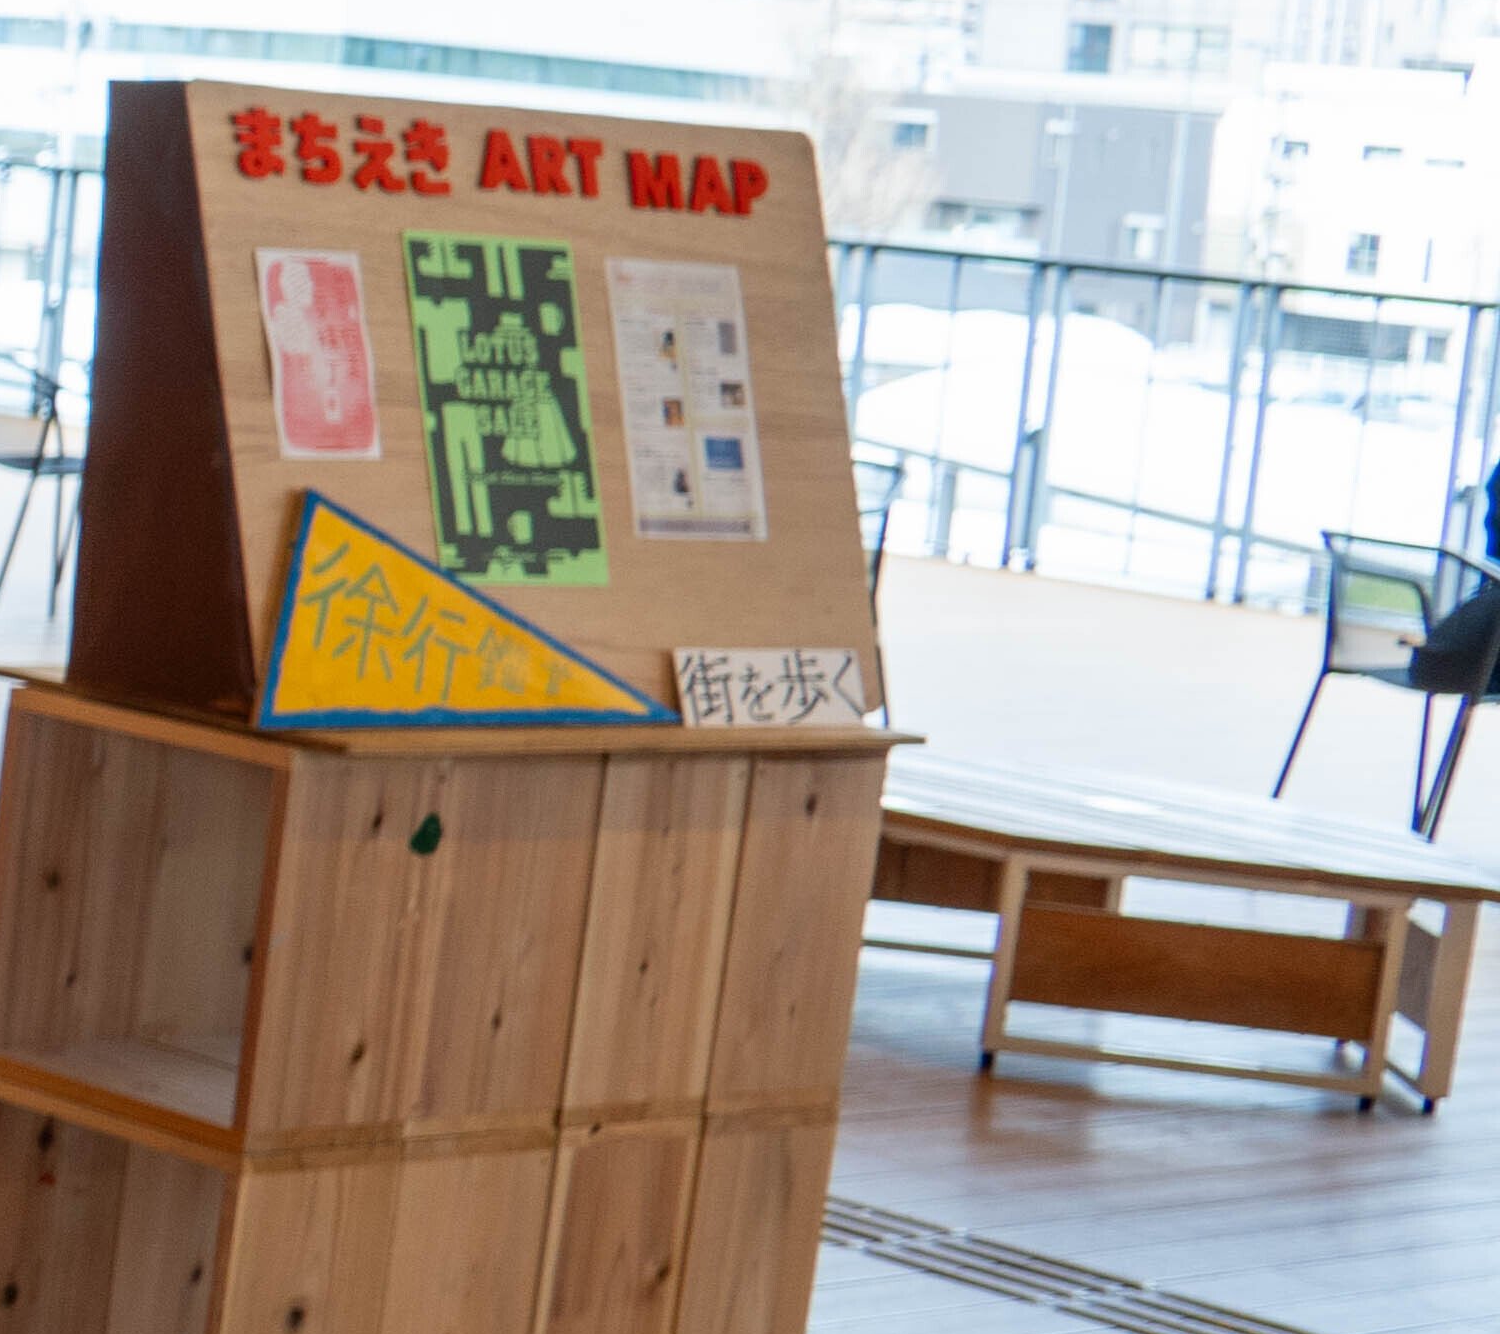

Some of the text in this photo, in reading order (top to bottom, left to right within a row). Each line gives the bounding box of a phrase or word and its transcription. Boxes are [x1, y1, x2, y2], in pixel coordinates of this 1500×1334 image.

[231, 106, 771, 217] まちえき ART MAP
[679, 649, 865, 726] 街を歩く
